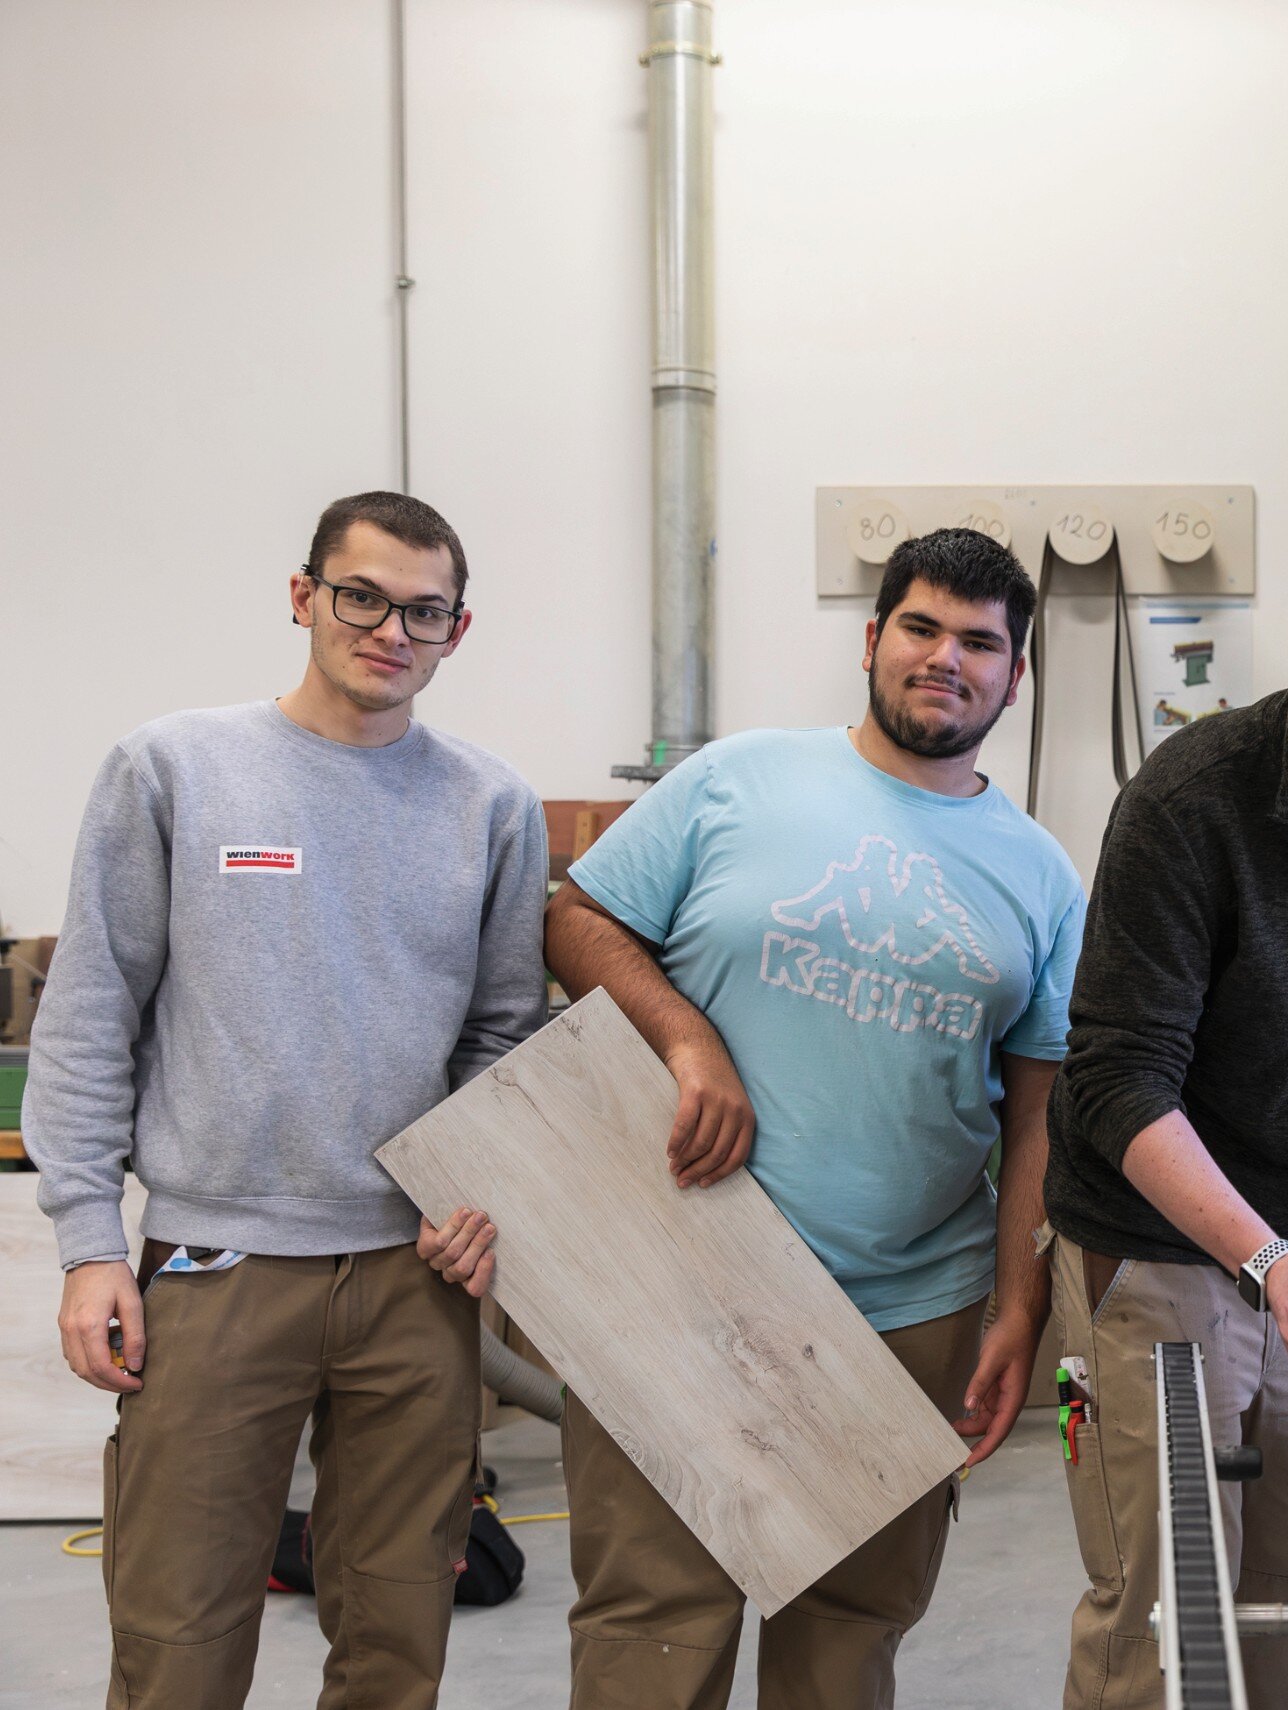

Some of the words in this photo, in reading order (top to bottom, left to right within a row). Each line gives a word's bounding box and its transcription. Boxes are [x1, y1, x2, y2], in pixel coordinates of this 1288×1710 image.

[860, 513, 896, 541] 80
[959, 514, 1005, 538] 100
[1056, 514, 1108, 541] 120
[1156, 512, 1211, 540] 150
[227, 851, 294, 860] wienwork
[760, 931, 983, 1041] Kappa
